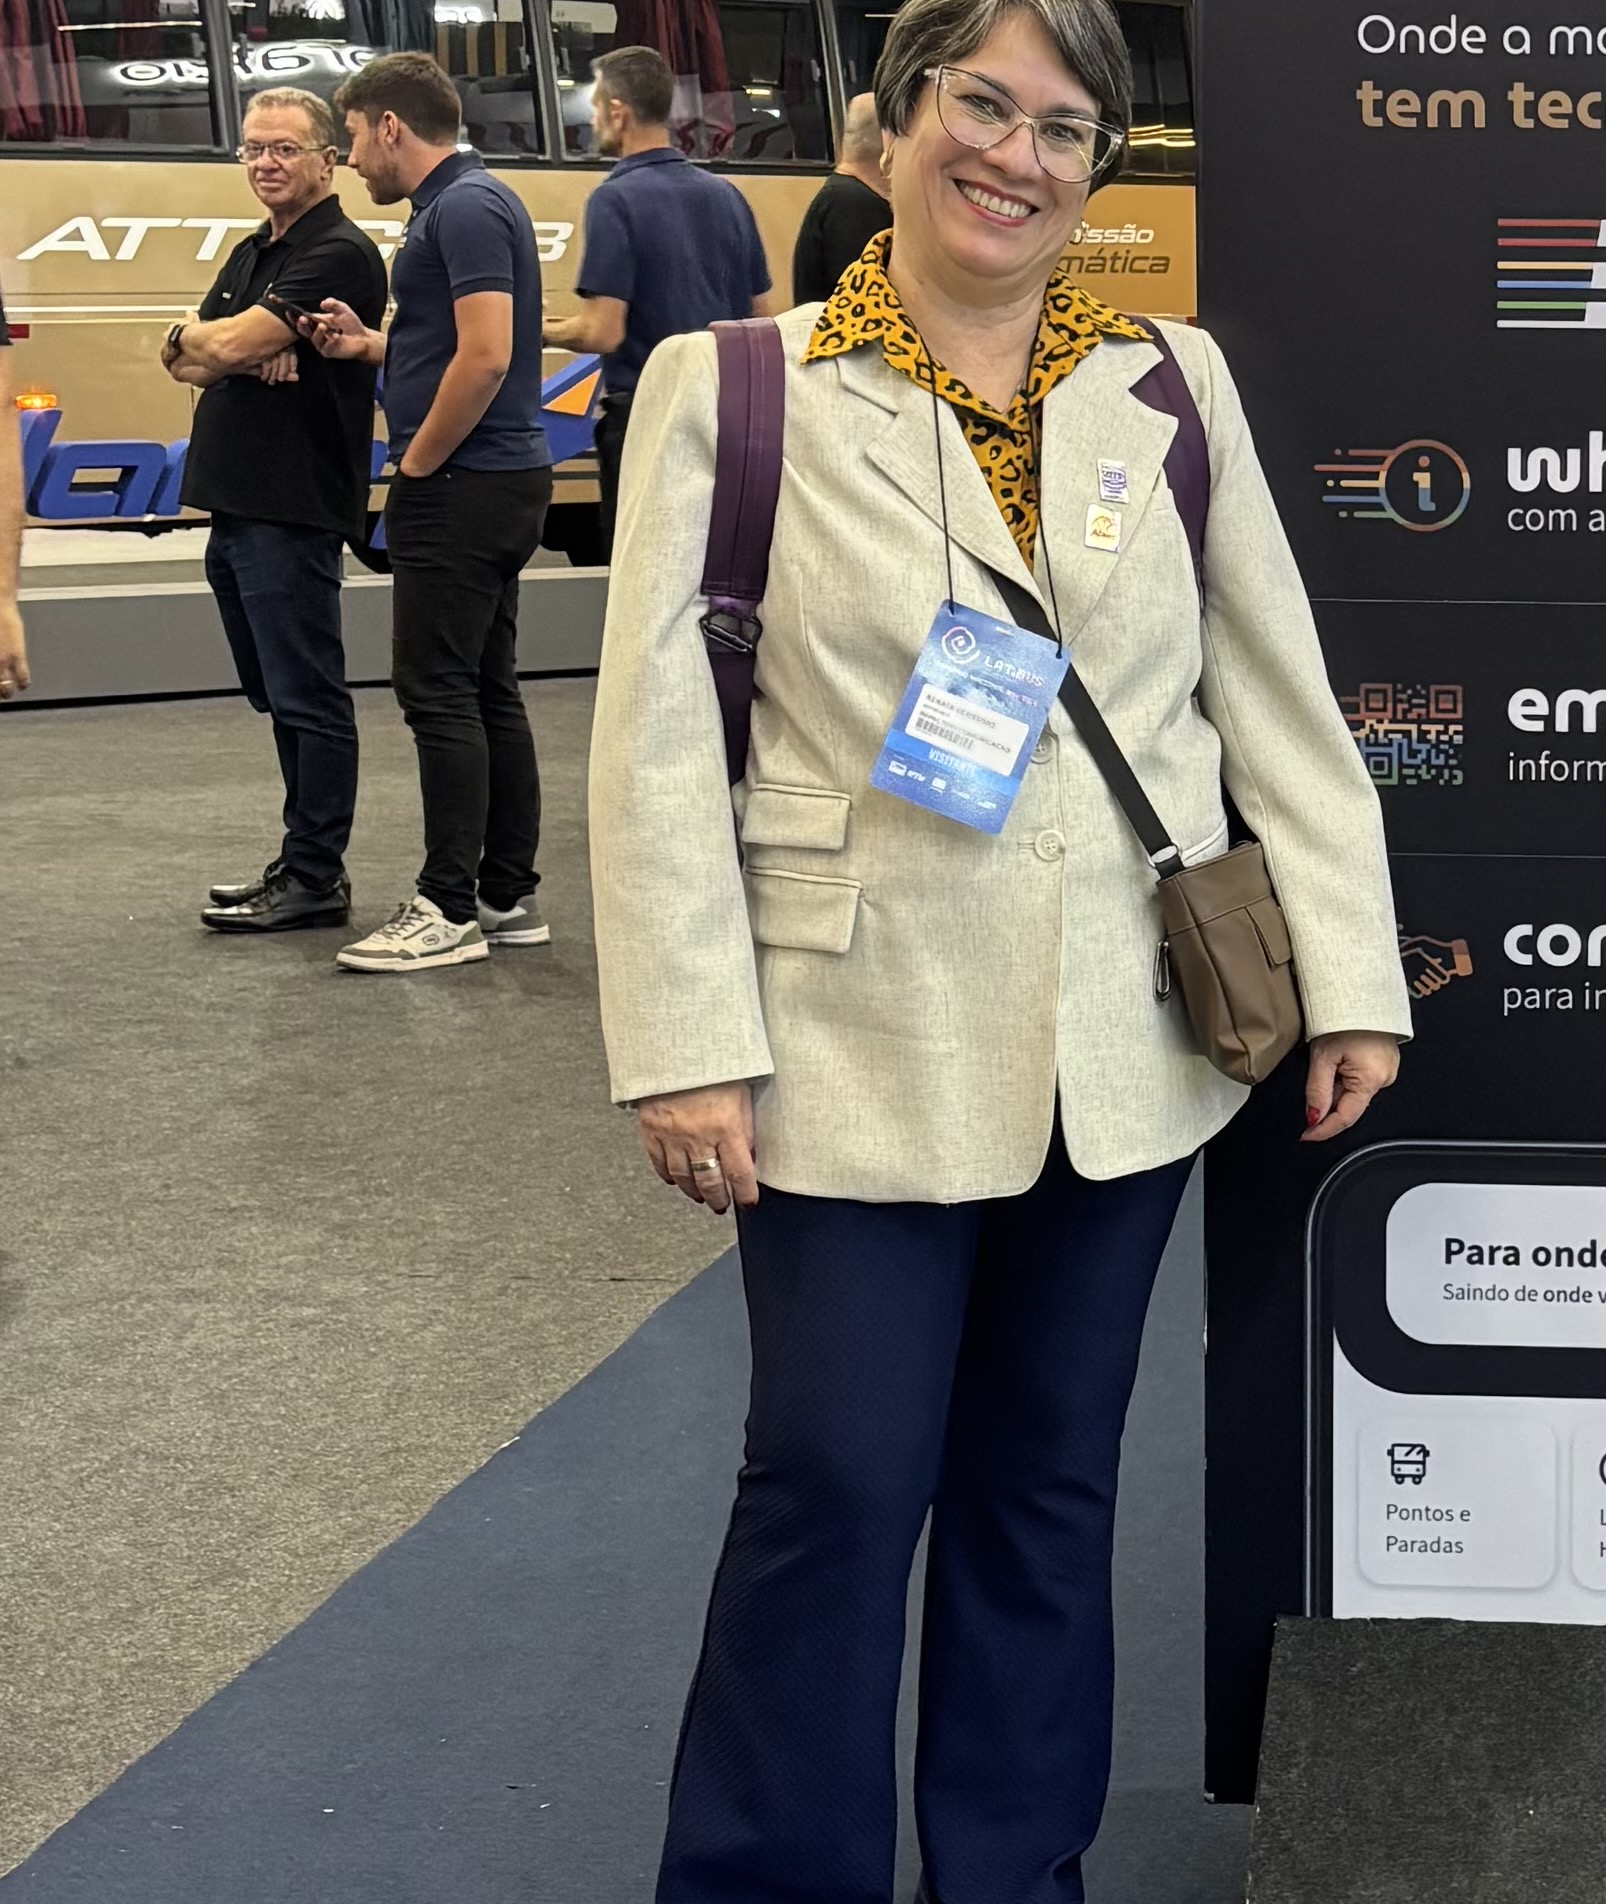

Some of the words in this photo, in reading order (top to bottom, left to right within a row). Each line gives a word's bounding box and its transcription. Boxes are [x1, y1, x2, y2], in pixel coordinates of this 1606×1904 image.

[1357, 13, 1487, 56] Onde
[1502, 26, 1531, 56] a
[1356, 80, 1486, 130] tem
[1058, 247, 1171, 275] mática
[1507, 508, 1577, 533] com
[1588, 510, 1606, 533] a
[1503, 988, 1573, 1017] para
[1444, 1237, 1521, 1267] Para
[1442, 1282, 1510, 1302] Saindo
[1514, 1284, 1539, 1303] de
[1542, 1285, 1594, 1304] onde
[1386, 1503, 1455, 1522] Pontos
[1459, 1509, 1471, 1522] e
[1386, 1535, 1464, 1554] Paradas
